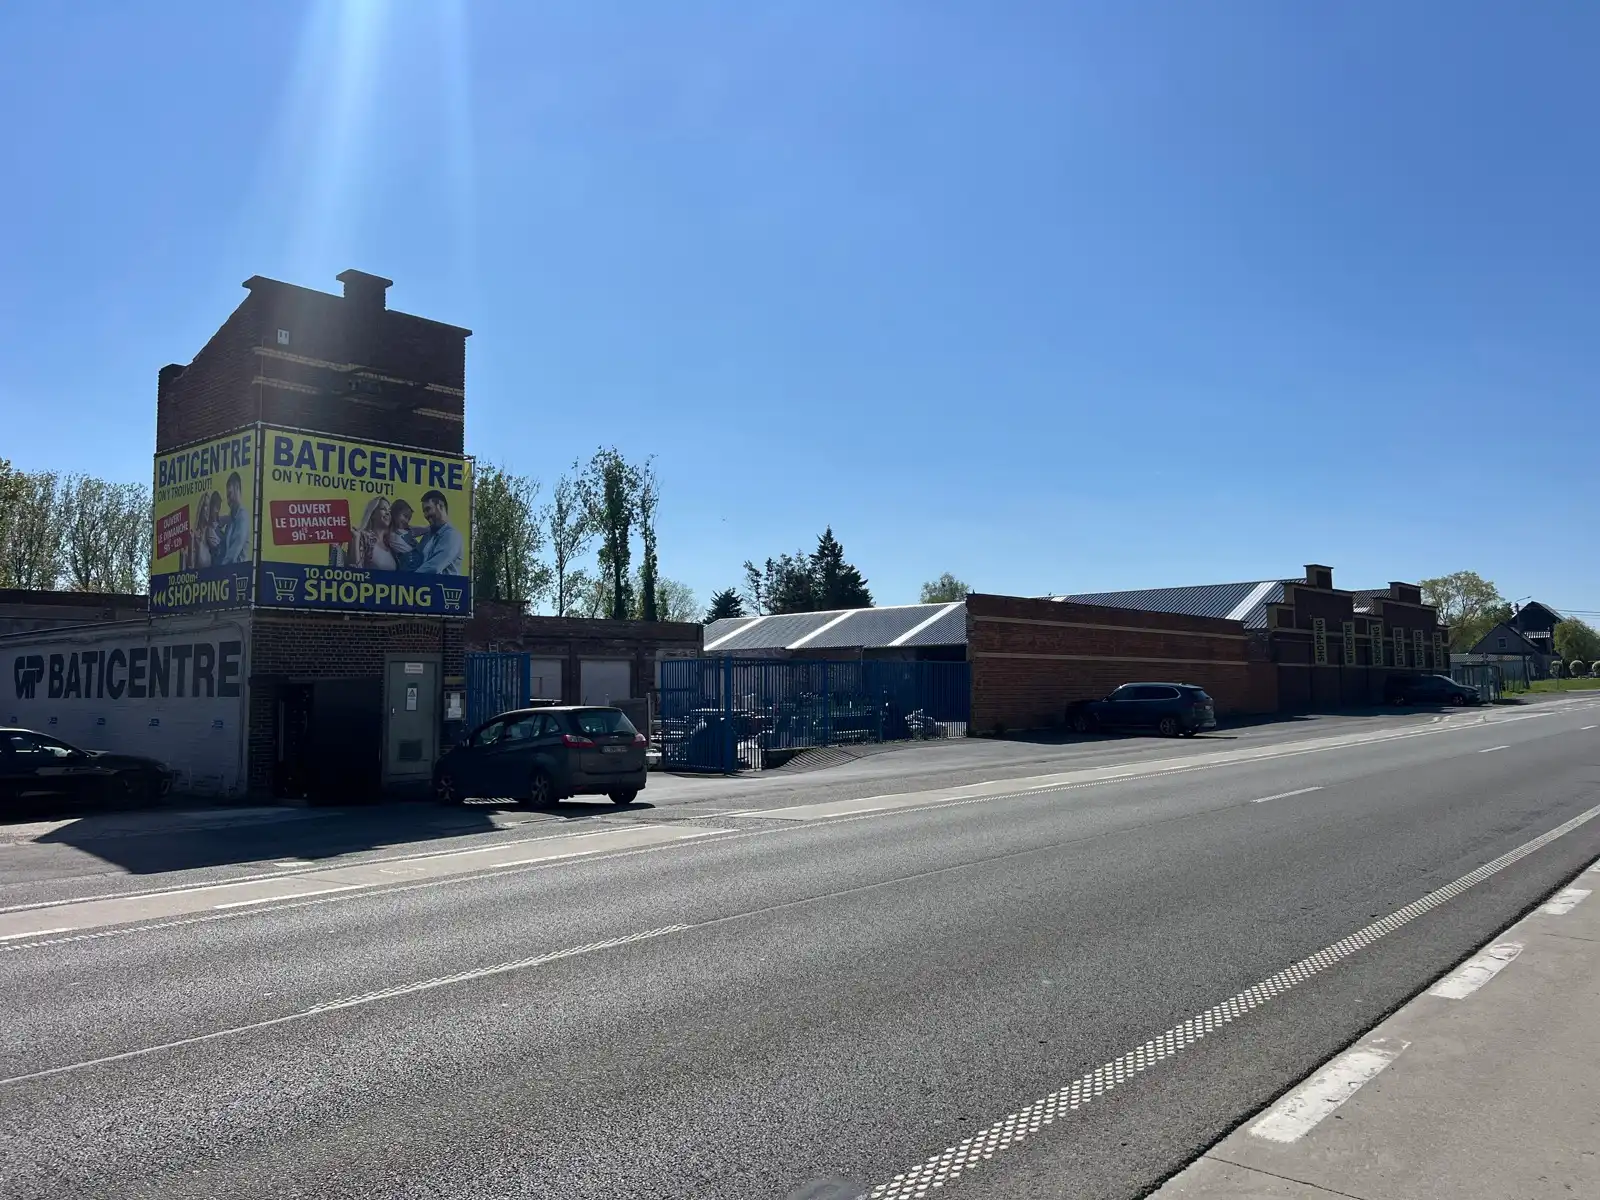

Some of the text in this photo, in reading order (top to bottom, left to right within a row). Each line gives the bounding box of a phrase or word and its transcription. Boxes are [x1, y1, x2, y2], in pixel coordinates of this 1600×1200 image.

[159, 435, 251, 488] BATICENTRE
[273, 435, 463, 491] BATICENTRE
[158, 489, 166, 502] ON
[171, 482, 193, 499] TROUVE
[195, 478, 213, 493] TOUT!
[272, 468, 394, 496] ON Y TROUVE TOUT!
[163, 512, 182, 529] OUVERT
[275, 516, 347, 528] LE DIMANCHE
[288, 503, 331, 514] OUVERT
[158, 520, 189, 545] LE DIMANCHE
[314, 529, 334, 540] 12h
[167, 579, 229, 607] SHOPPING
[304, 579, 432, 607] SHOPPING
[1315, 619, 1325, 662] SHOPPING
[1345, 624, 1354, 664] BATICENTRE
[1372, 626, 1382, 664] SHOPPING
[47, 641, 242, 700] BATICENTRE
